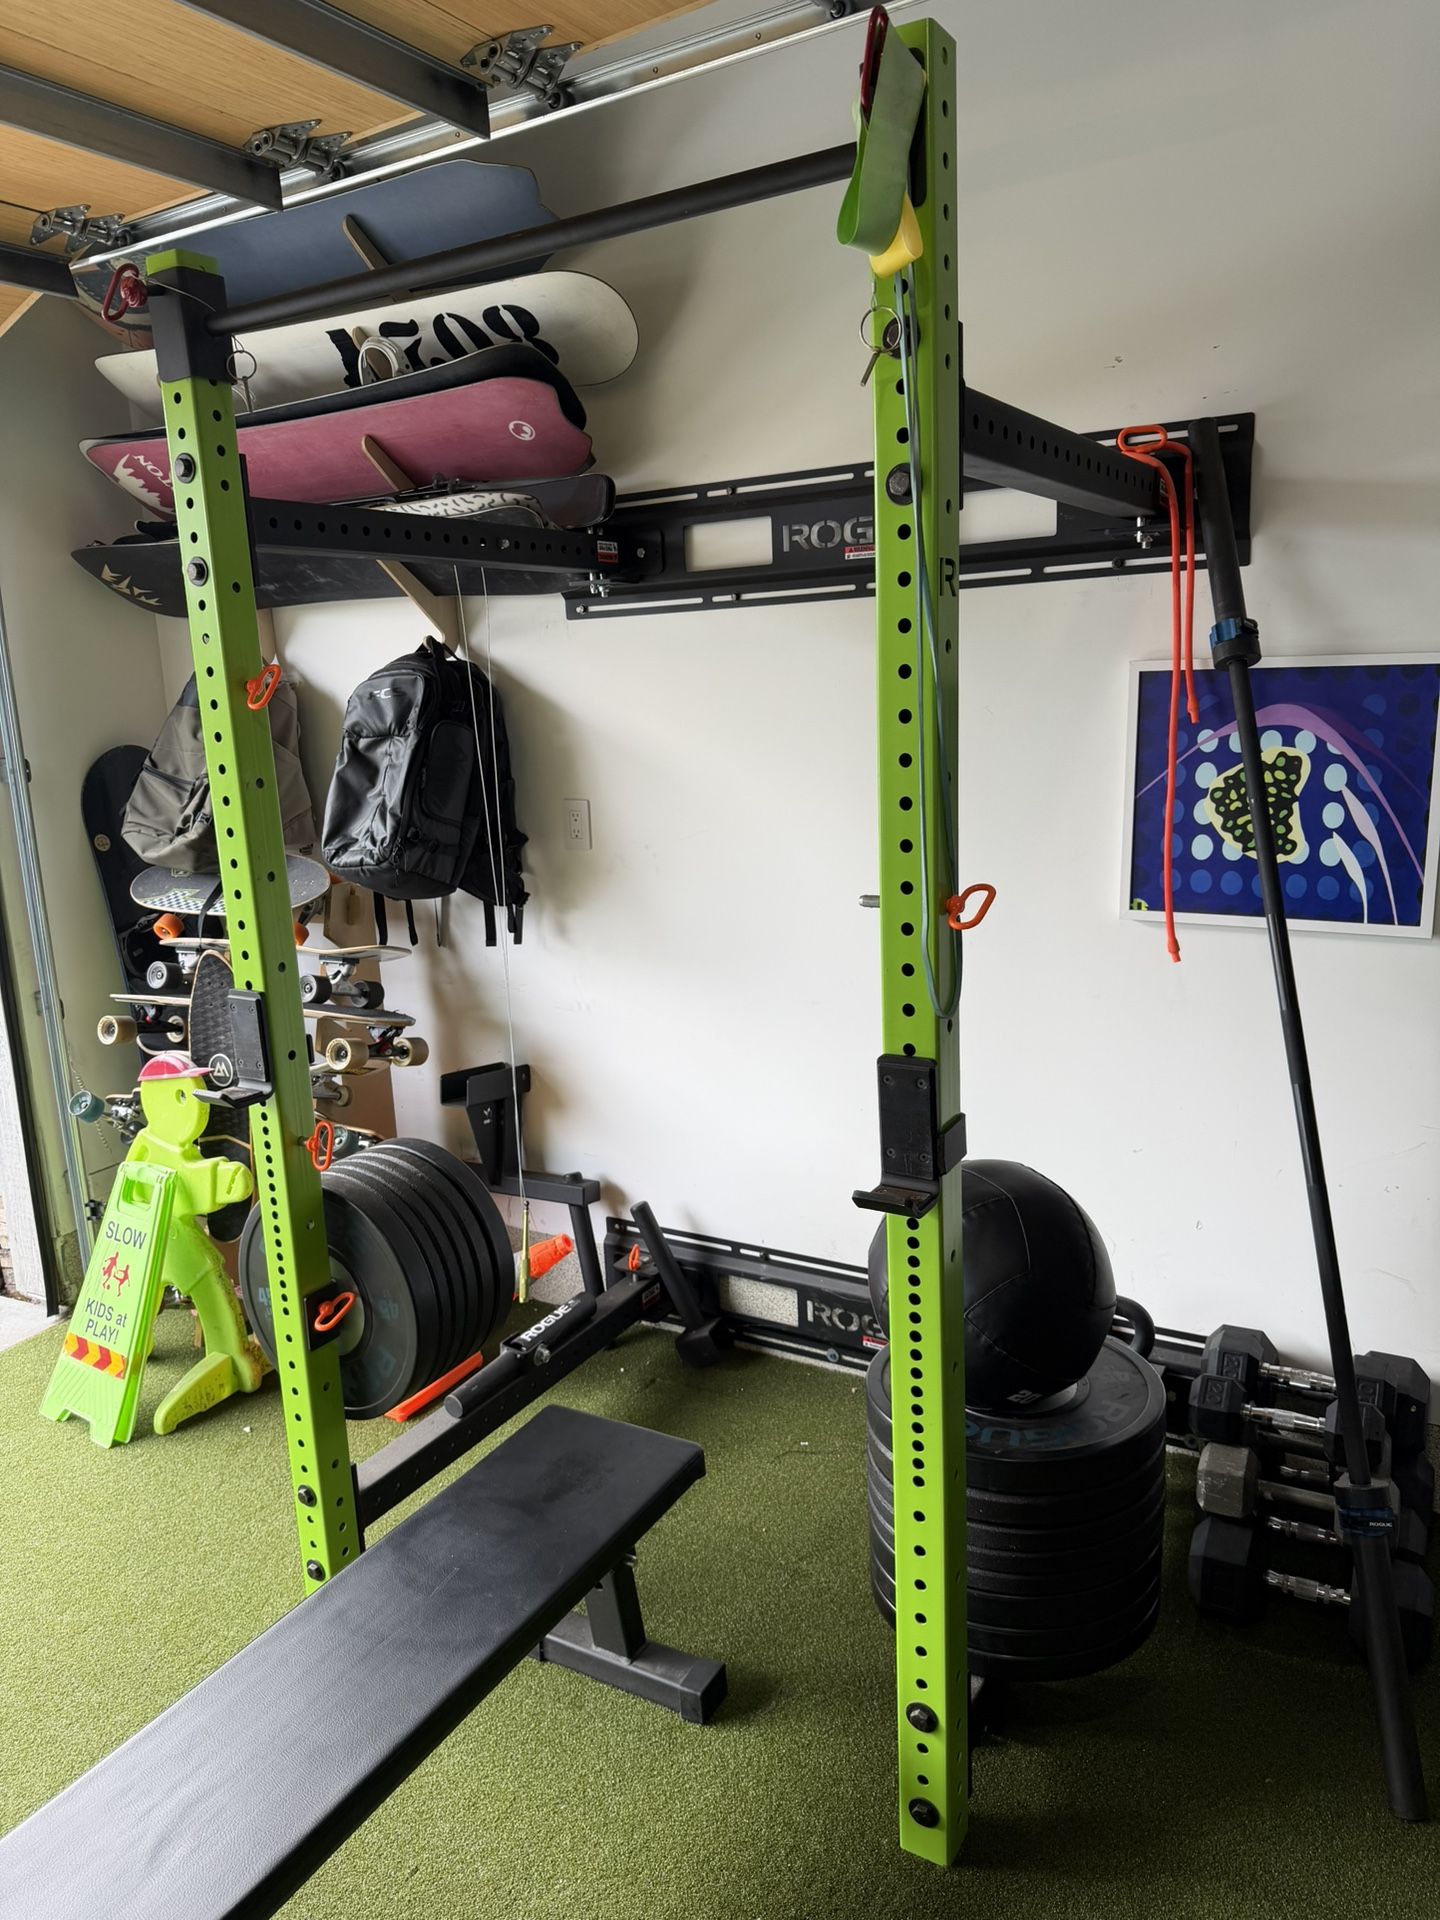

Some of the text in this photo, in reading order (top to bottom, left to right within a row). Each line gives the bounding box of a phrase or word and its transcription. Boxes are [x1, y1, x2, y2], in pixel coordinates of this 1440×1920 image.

[105, 1220, 147, 1250] SLOW
[85, 1298, 128, 1328] KIDS at
[520, 1304, 573, 1342] ROGUE
[85, 1319, 119, 1345] PLAY!
